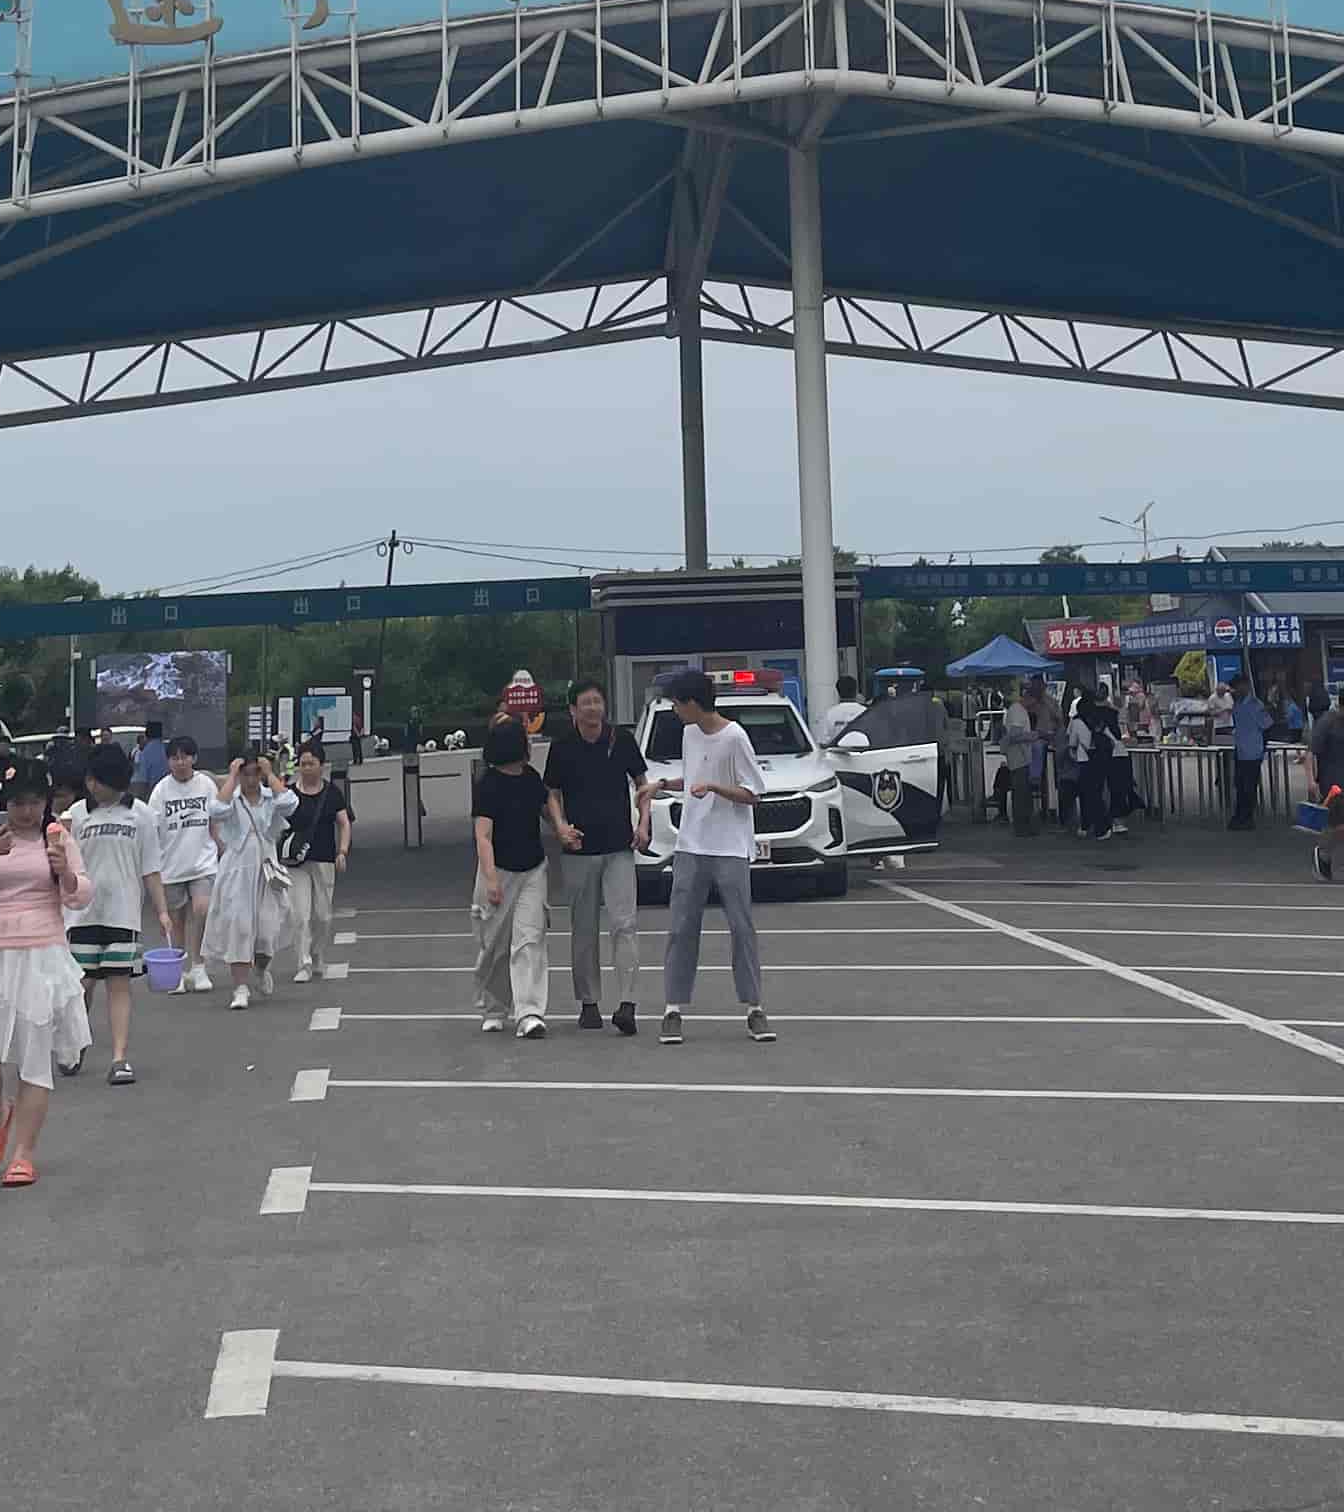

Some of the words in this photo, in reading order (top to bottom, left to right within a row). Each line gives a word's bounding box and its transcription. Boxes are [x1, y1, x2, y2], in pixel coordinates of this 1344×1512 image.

[293, 595, 362, 616] 出口
[473, 587, 540, 607] 出口
[111, 605, 180, 626] 出口
